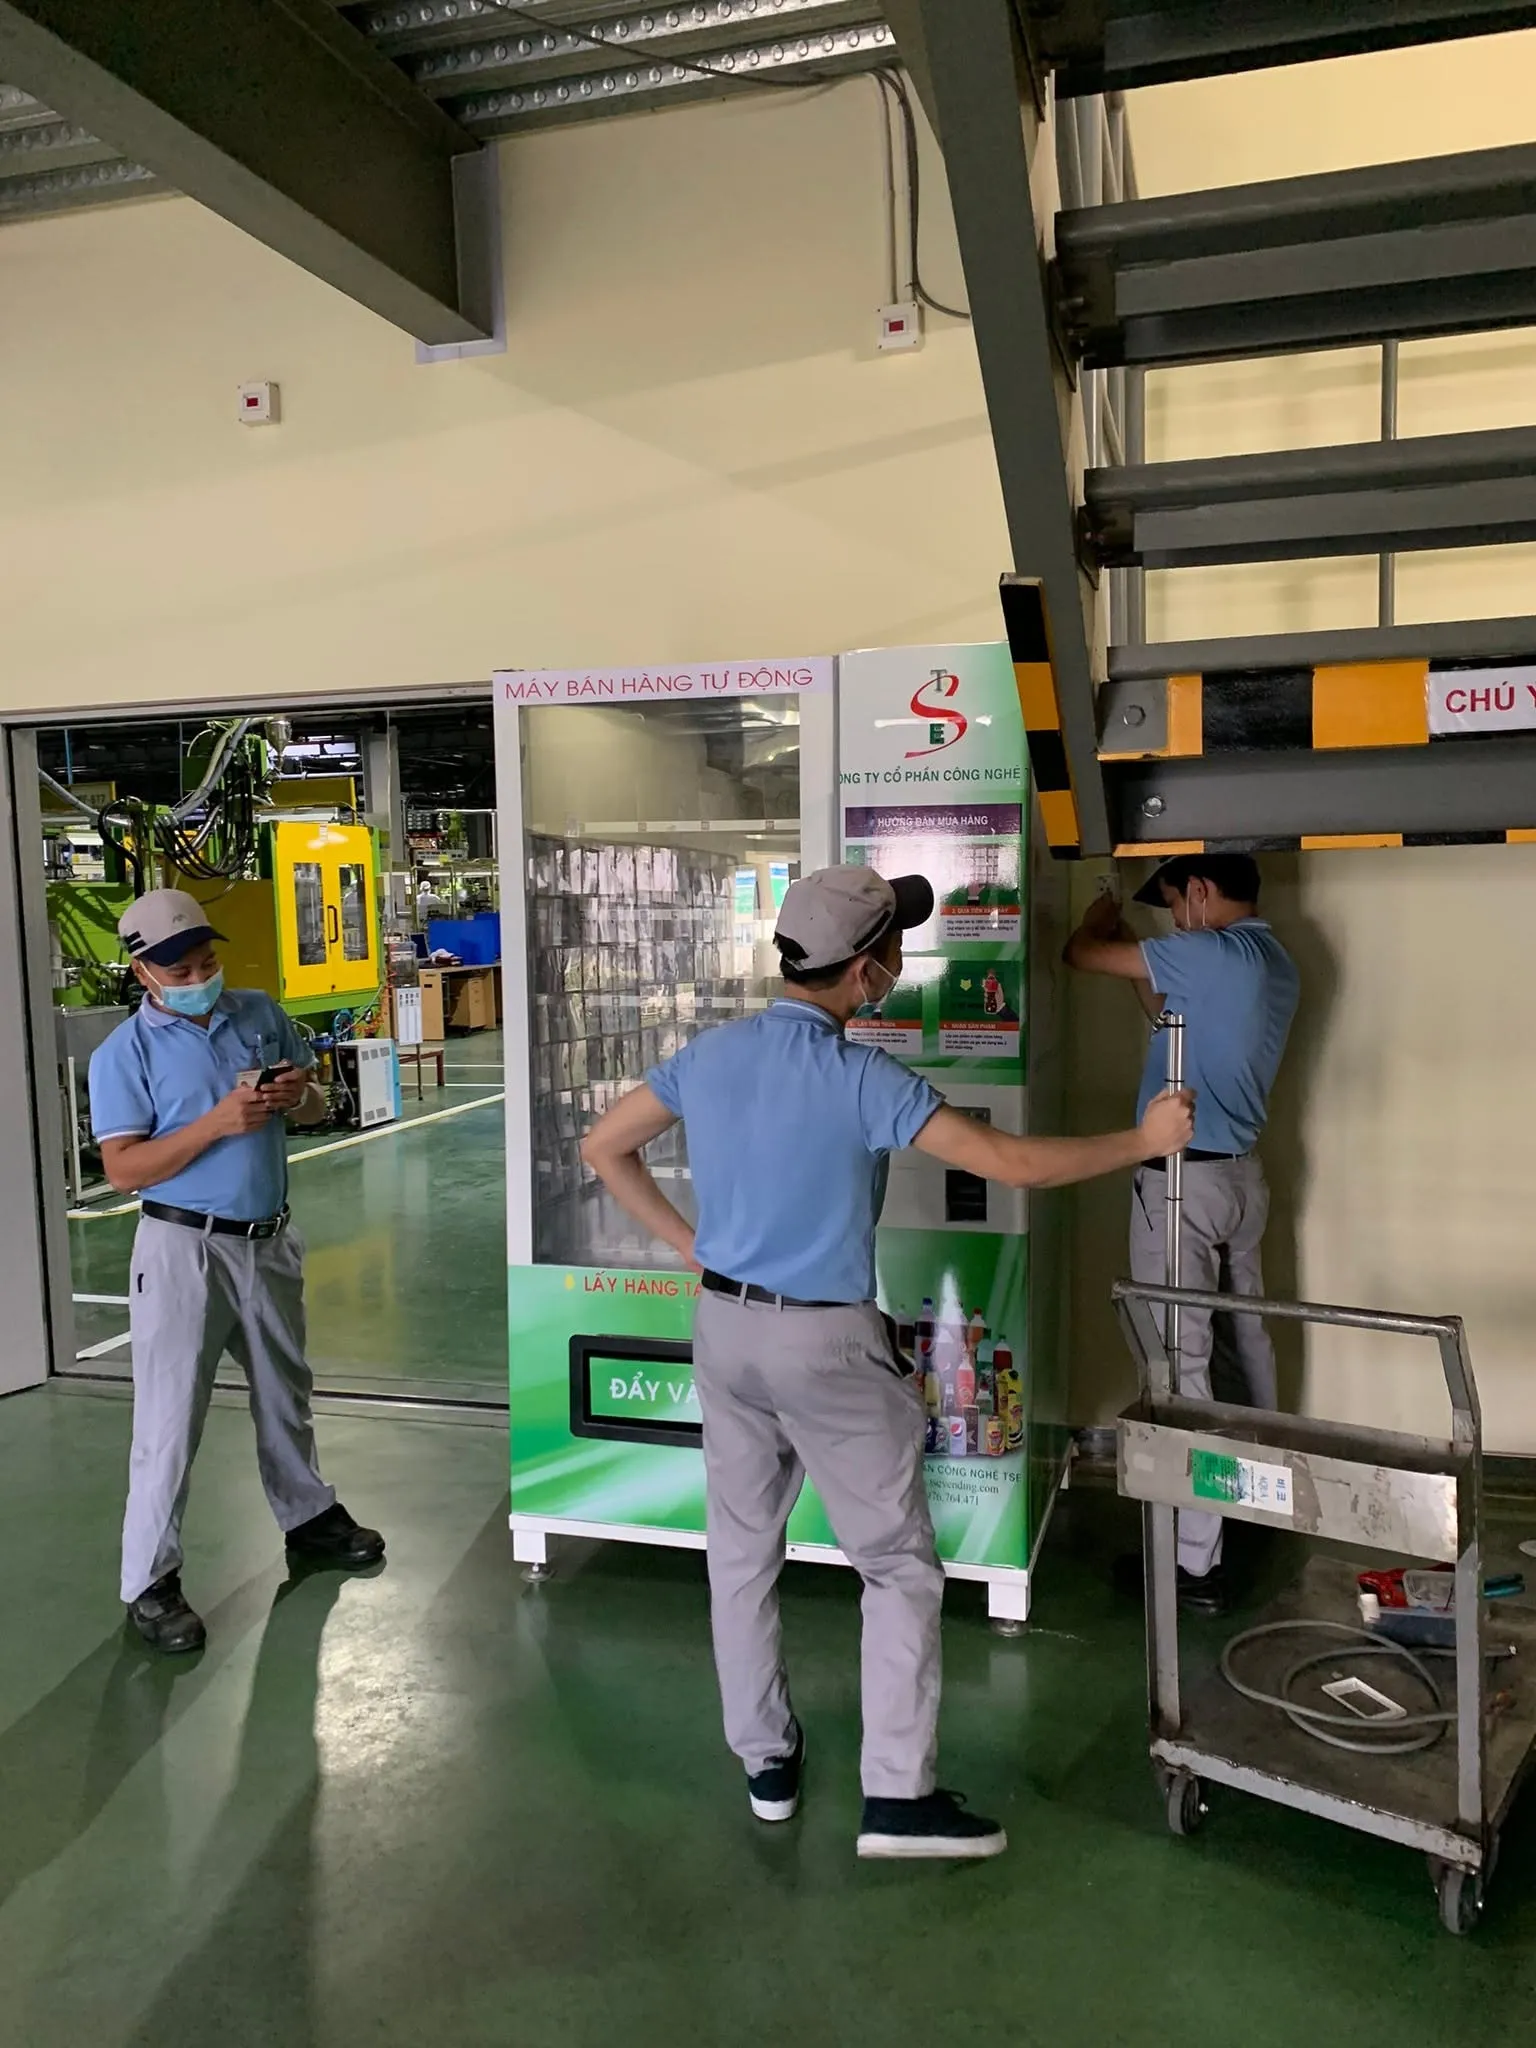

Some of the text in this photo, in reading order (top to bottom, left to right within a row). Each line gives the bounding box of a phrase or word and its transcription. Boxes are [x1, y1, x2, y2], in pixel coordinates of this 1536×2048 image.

[506, 667, 813, 699] MÁY BÁN HÀNG TỰ ĐỘNG
[1445, 681, 1515, 713] CHÚ
[864, 771, 880, 784] TY
[884, 765, 901, 783] CỔ
[943, 766, 980, 782] CÔNG
[960, 813, 988, 826] HÀNG
[584, 1271, 618, 1293] LẤY
[624, 1274, 679, 1297] HÀNG
[609, 1371, 661, 1401] ĐẨY
[1003, 1471, 1022, 1483] TSE
